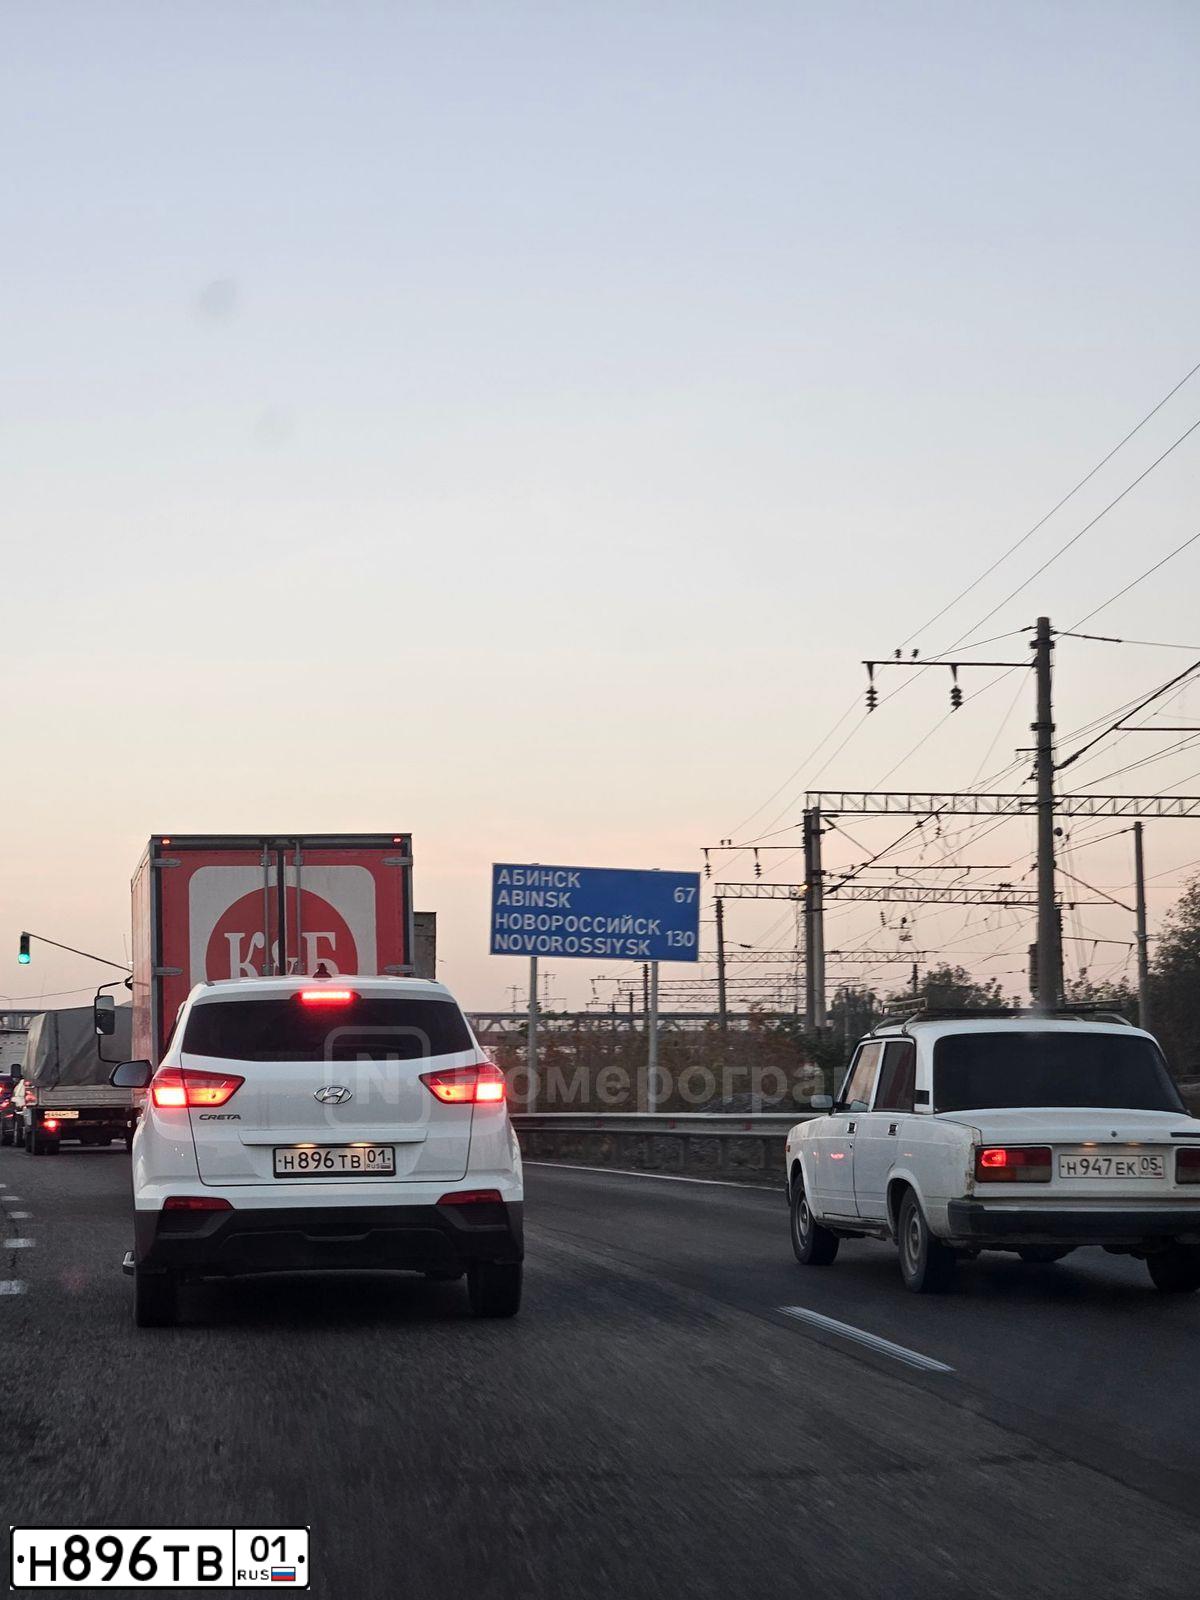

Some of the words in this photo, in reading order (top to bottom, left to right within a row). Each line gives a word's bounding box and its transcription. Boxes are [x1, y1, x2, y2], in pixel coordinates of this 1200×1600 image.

[497, 869, 581, 888] АБИНСК
[496, 890, 572, 908] ABINSK
[673, 887, 696, 903] 67
[495, 913, 661, 936] НОВОРОССИЙСК
[495, 934, 651, 955] NOVOROSSIYSK
[665, 931, 695, 947] 130
[199, 1113, 241, 1121] CRETA
